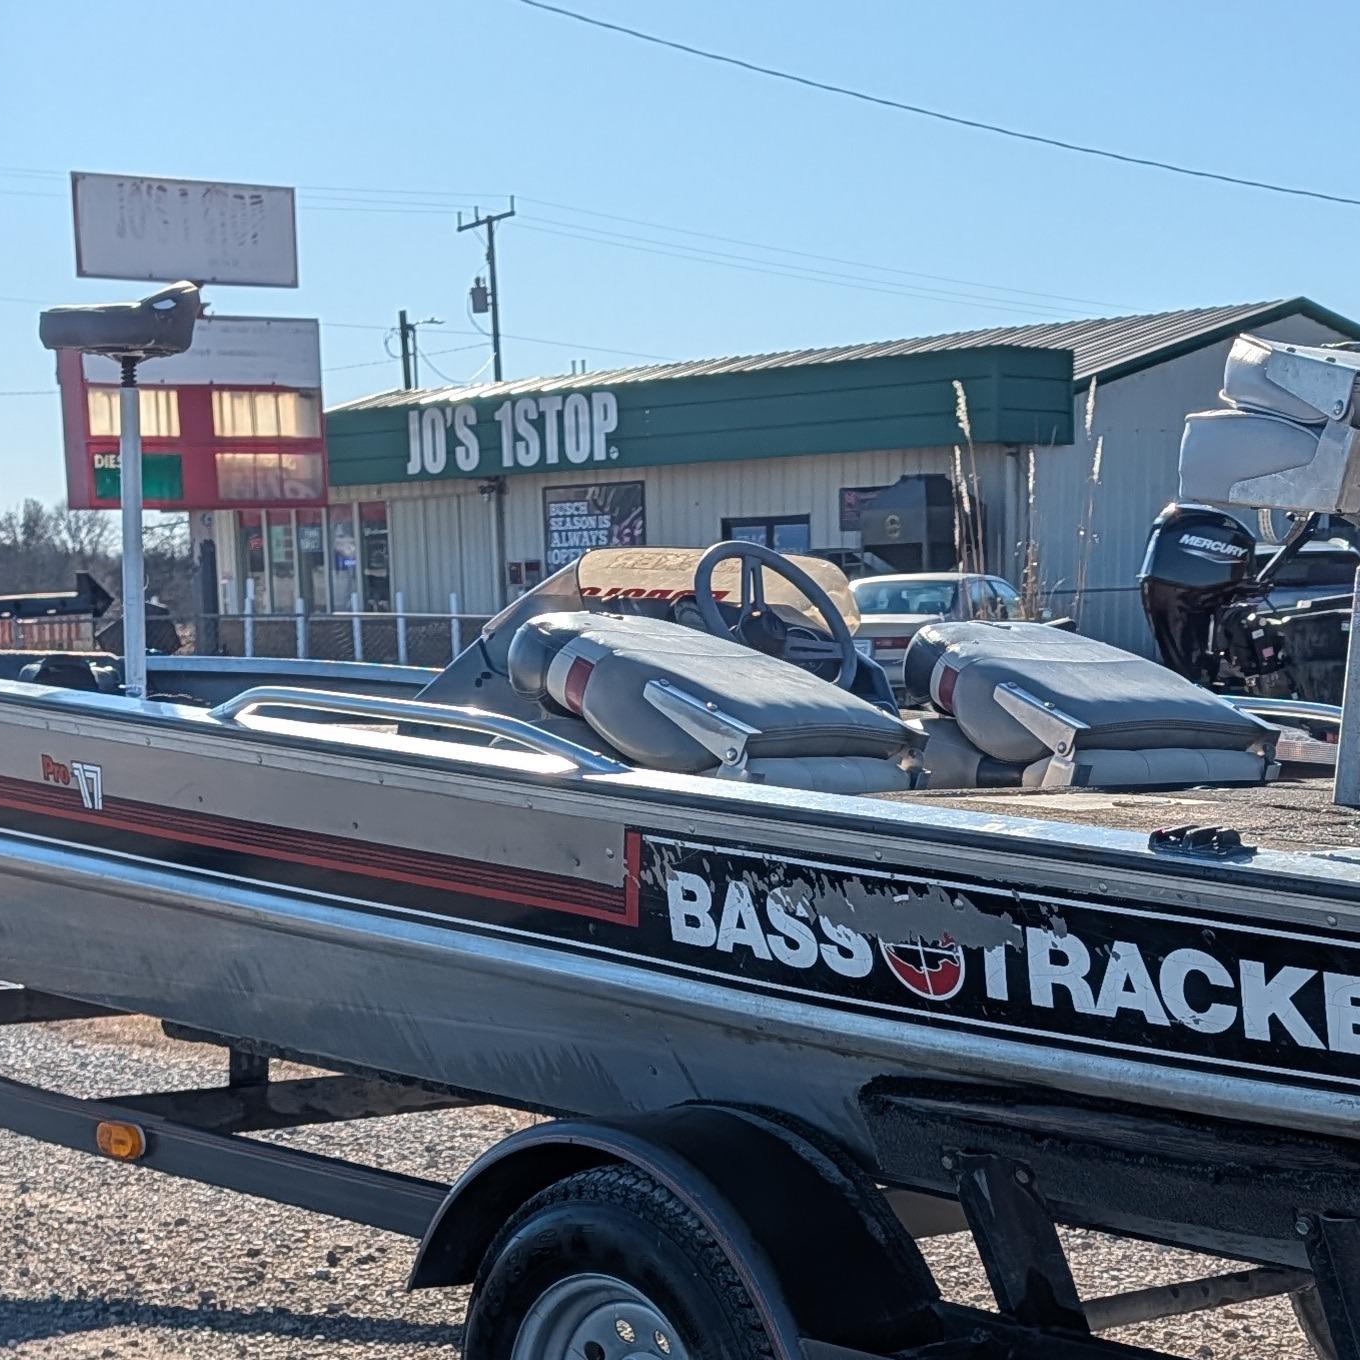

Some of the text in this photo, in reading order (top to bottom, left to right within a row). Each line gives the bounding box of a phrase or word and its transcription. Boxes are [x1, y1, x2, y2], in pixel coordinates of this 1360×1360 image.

[406, 404, 480, 475] JO'S
[549, 502, 588, 516] BUSCH
[549, 515, 611, 531] SEASON IS
[550, 530, 609, 548] ALWAYS
[1178, 533, 1249, 558] MERCURY
[551, 549, 584, 566] OPE
[41, 753, 71, 786] Pro
[666, 869, 875, 979] BASS
